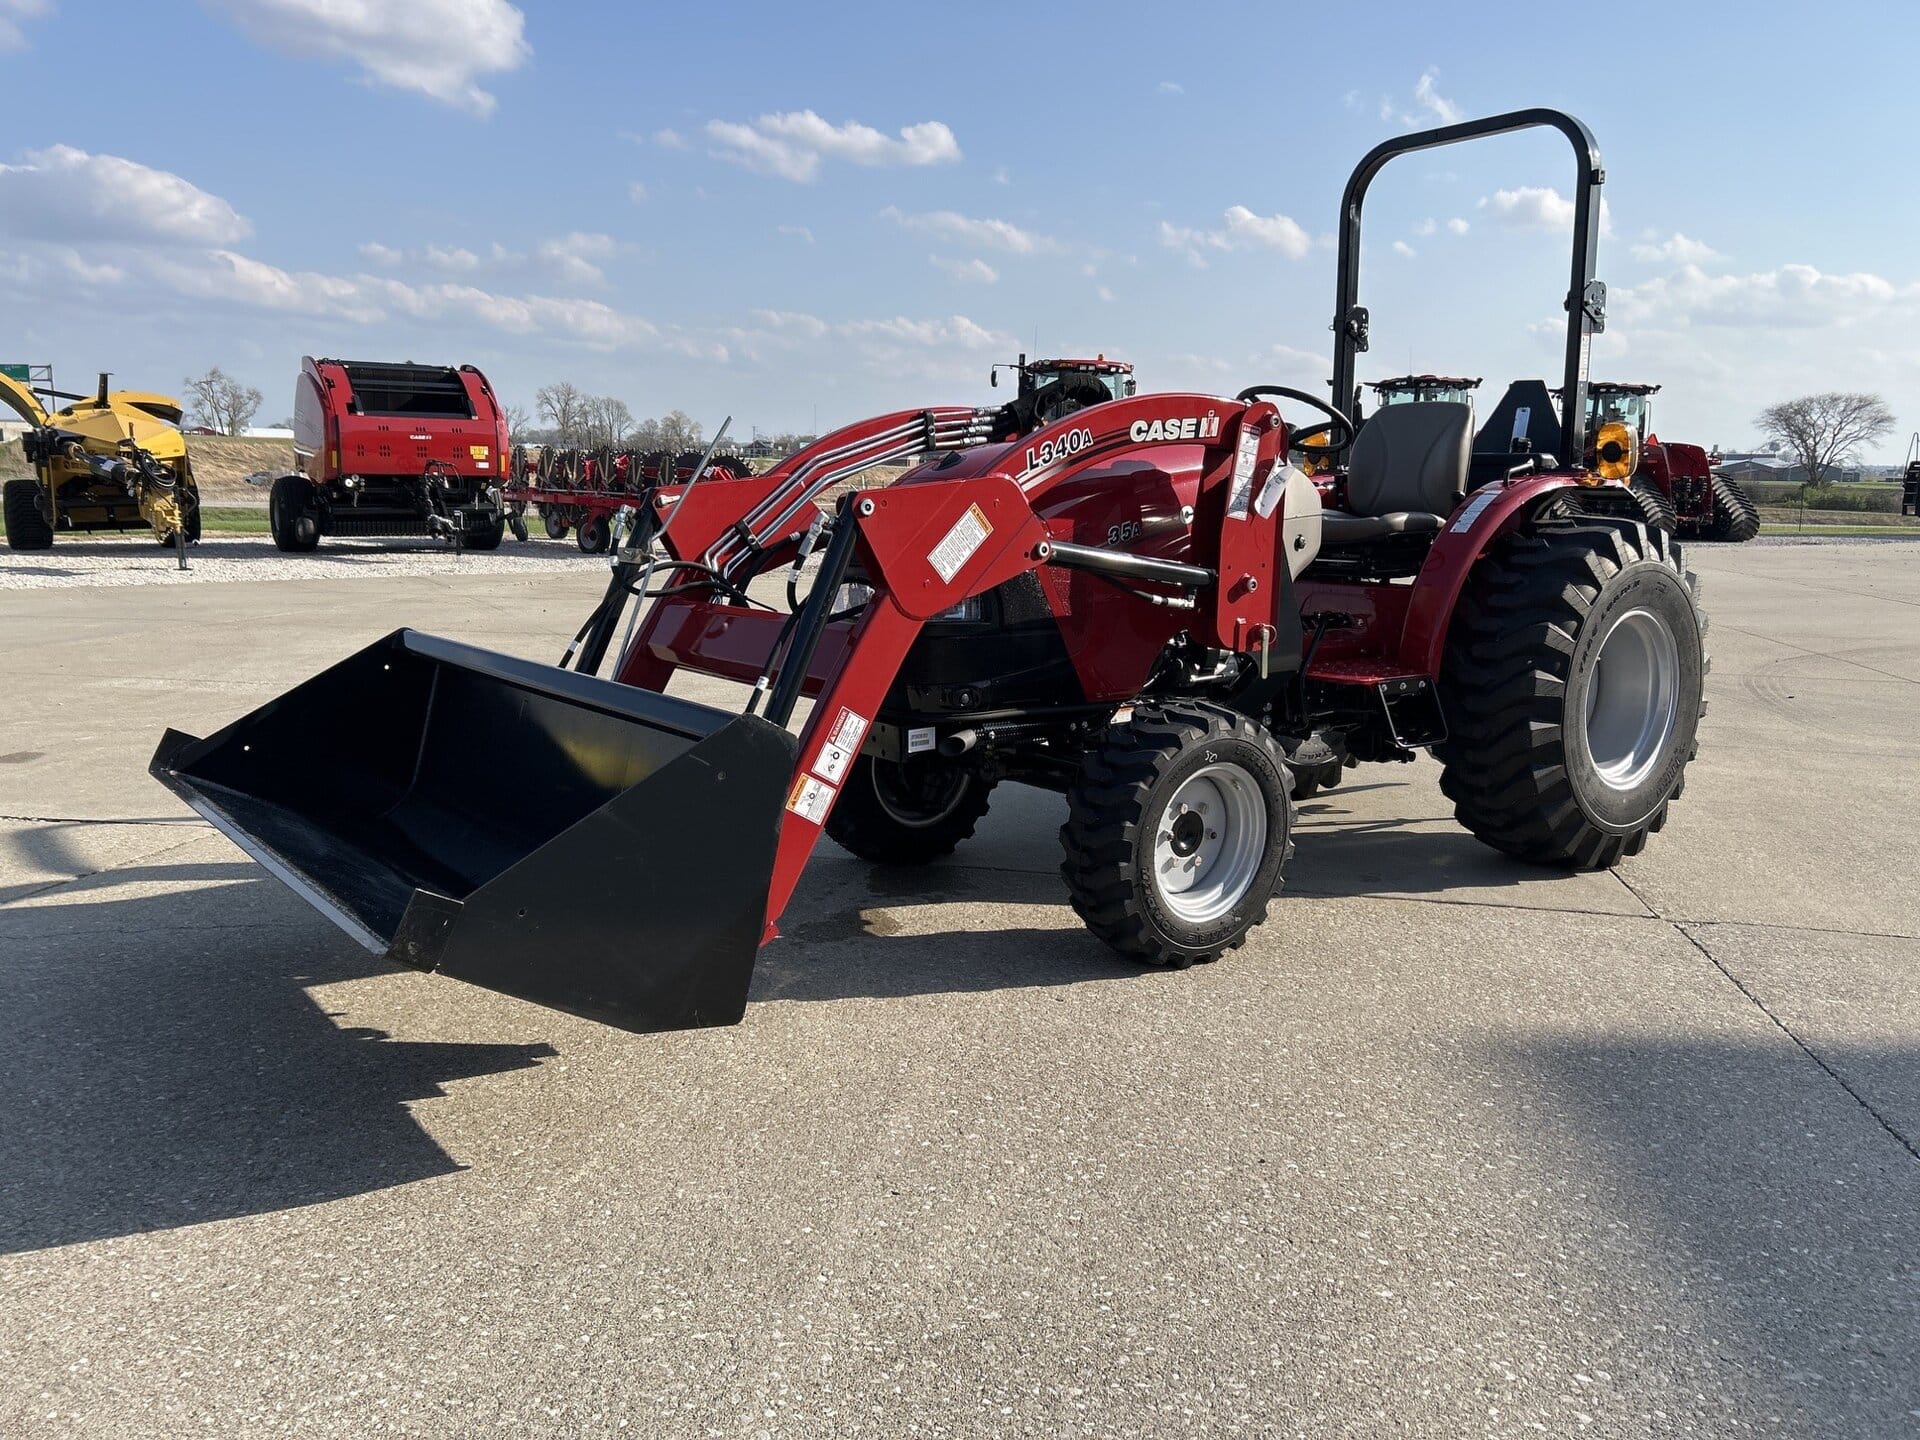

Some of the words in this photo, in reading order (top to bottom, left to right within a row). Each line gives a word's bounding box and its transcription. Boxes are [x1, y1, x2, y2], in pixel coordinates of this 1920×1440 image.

[1129, 417, 1197, 443] CASE
[1026, 428, 1094, 472] L340A
[1107, 521, 1142, 545] 35A
[833, 709, 849, 737] DANGER
